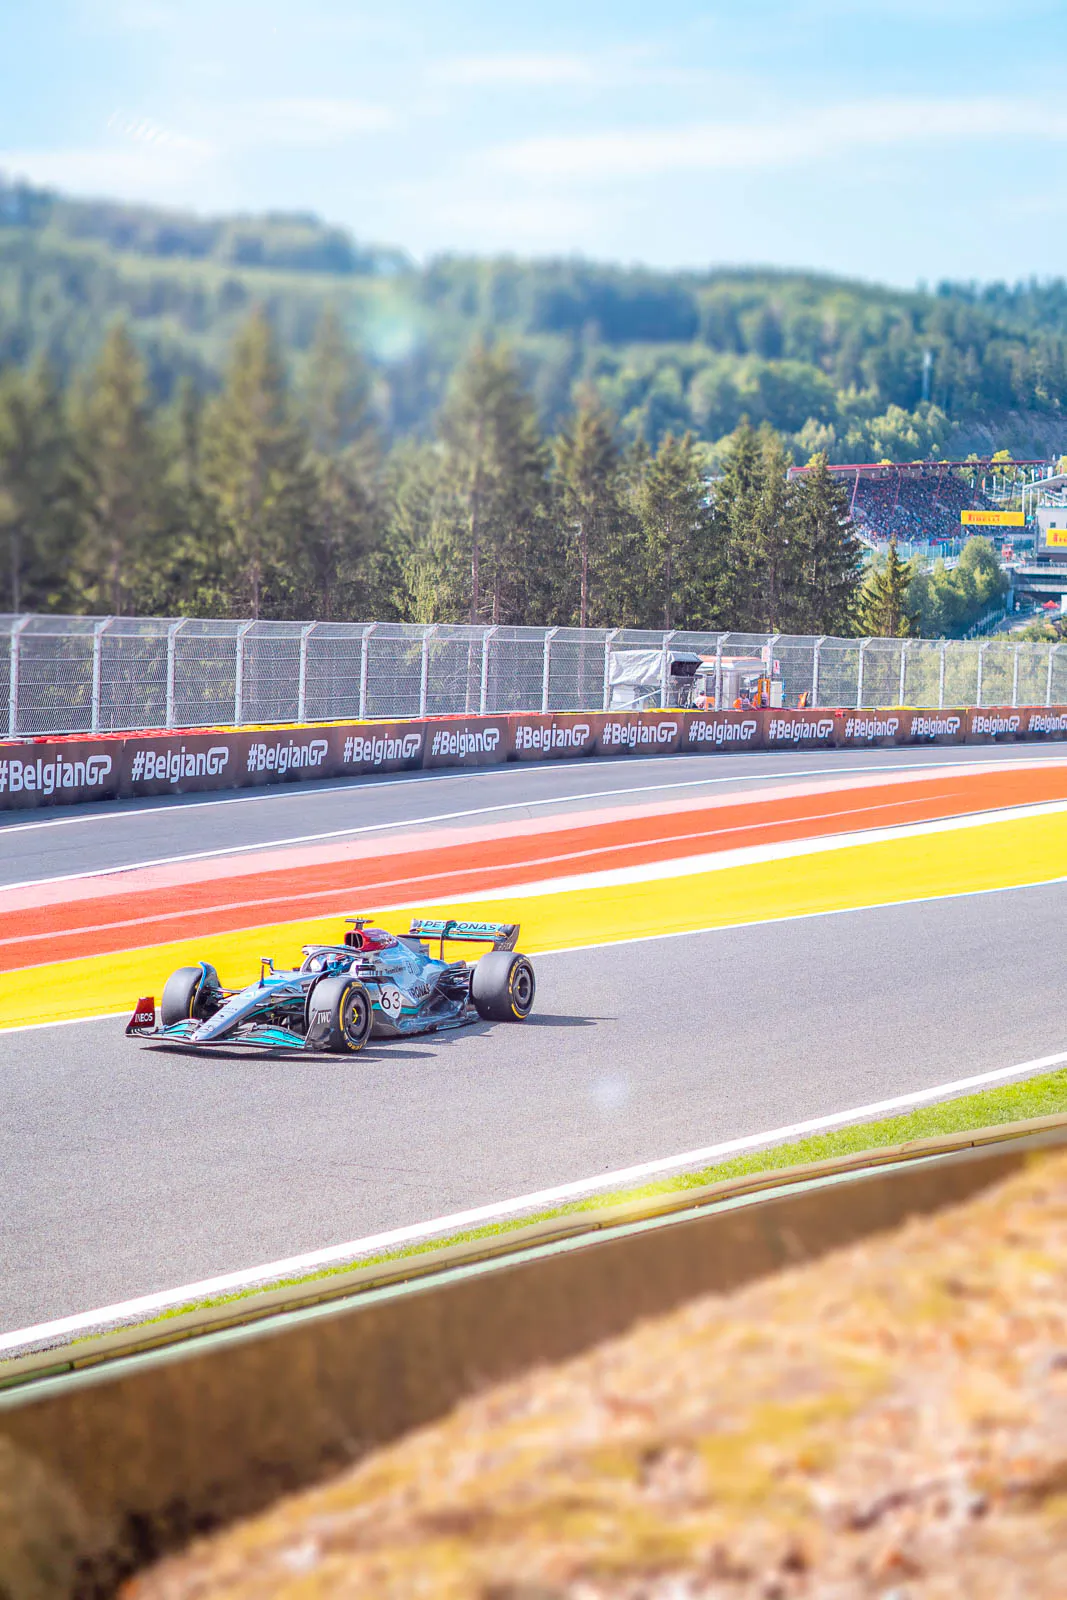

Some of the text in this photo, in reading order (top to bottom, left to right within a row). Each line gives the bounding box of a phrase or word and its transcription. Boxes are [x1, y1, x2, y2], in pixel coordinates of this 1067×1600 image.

[515, 722, 590, 751] #BelgianGP
[602, 720, 678, 746] #BelgianGP
[688, 719, 757, 744] #BelgianGP
[769, 718, 834, 742] #BelgianGP
[845, 717, 899, 740] #BelgianGP
[910, 714, 961, 739] #BelgianGP
[971, 713, 1020, 736] #BelgianGP
[343, 733, 422, 765] #BelgianGP
[431, 728, 500, 758] #BelgianGP
[131, 746, 229, 783] #BelgianGP
[247, 739, 328, 774] #BelgianGP
[424, 920, 497, 931] PETONAS
[380, 991, 400, 1009] 63
[135, 1012, 153, 1023] INEOS
[317, 1011, 332, 1025] IWC
